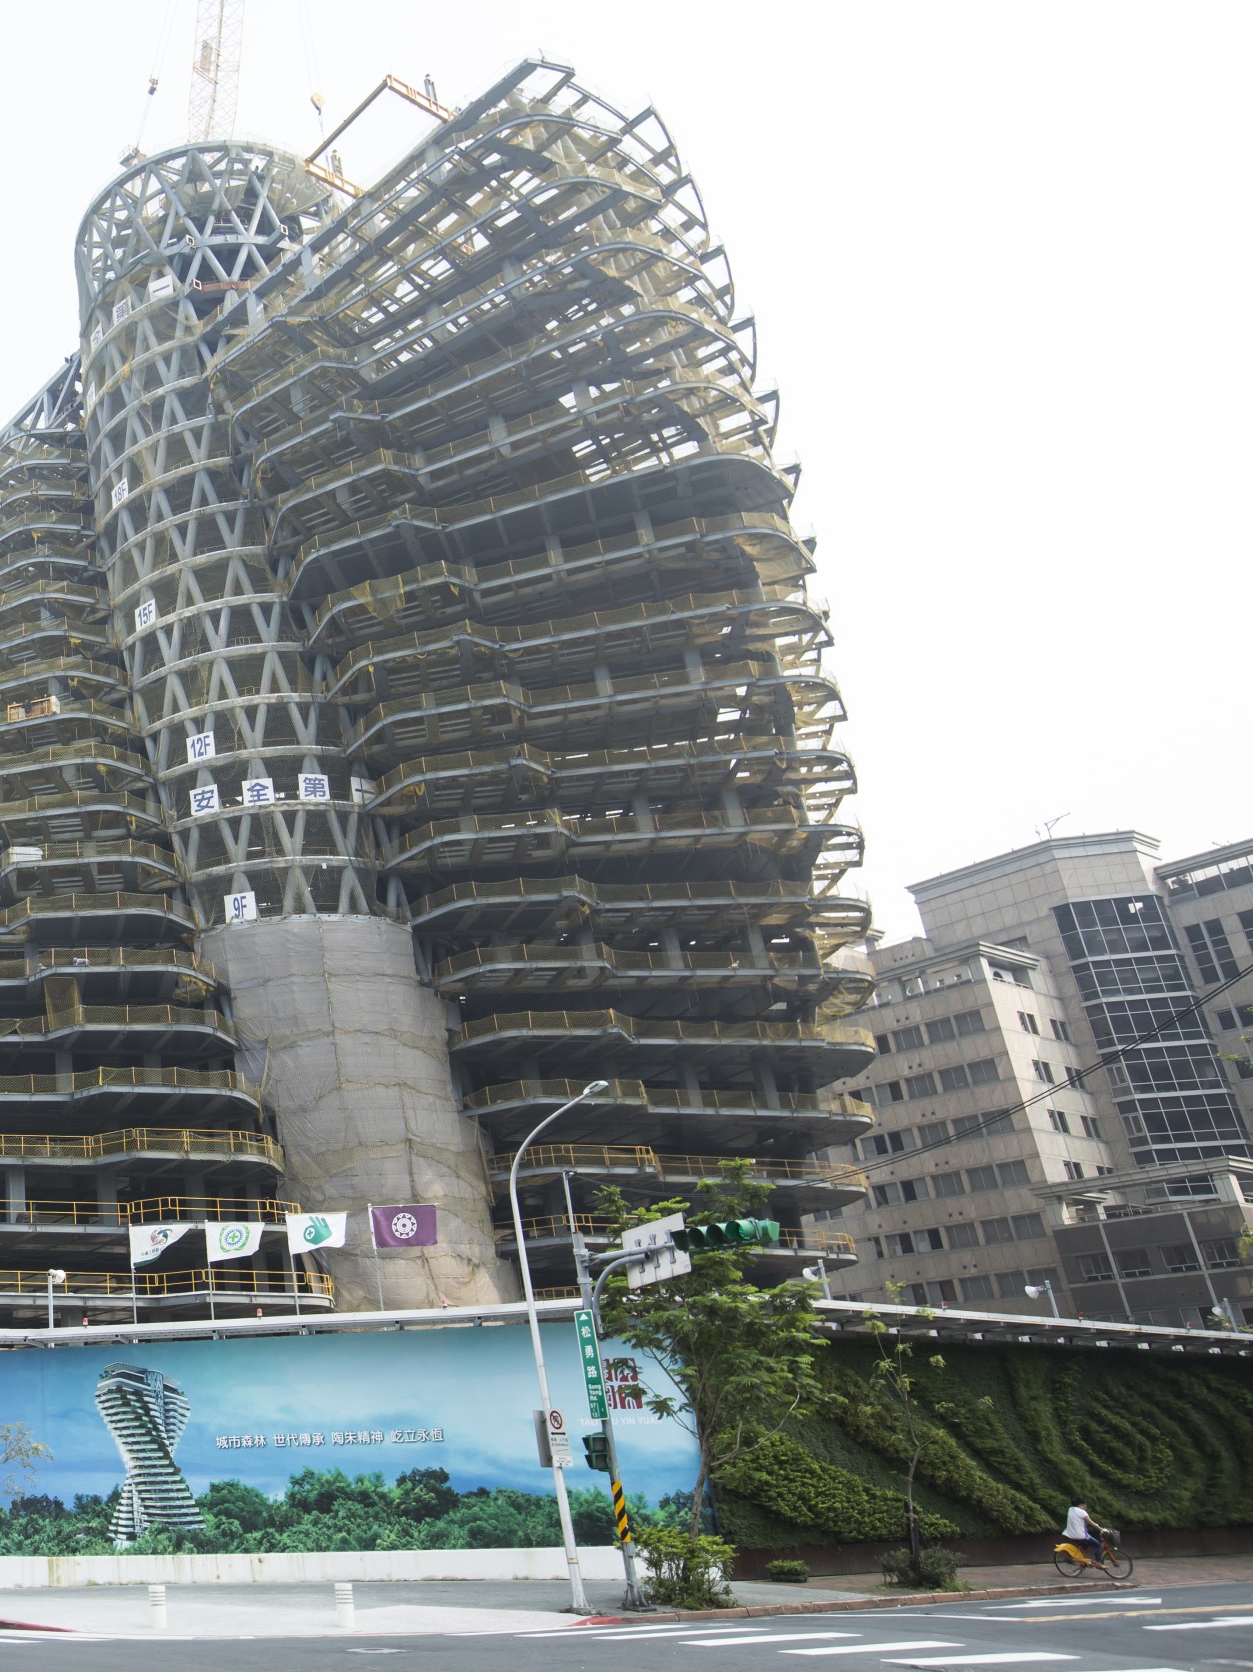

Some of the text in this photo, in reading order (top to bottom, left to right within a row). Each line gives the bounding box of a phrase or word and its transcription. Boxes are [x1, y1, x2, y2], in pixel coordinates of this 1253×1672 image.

[114, 481, 127, 504] 18F
[137, 602, 153, 627] 15F
[190, 735, 210, 758] 12F
[233, 895, 247, 918] 9F
[581, 1326, 597, 1378] 松勇路
[216, 1435, 266, 1449] 城市森林
[273, 1432, 325, 1447] 世代傳承
[331, 1430, 384, 1445] 陶朱精神
